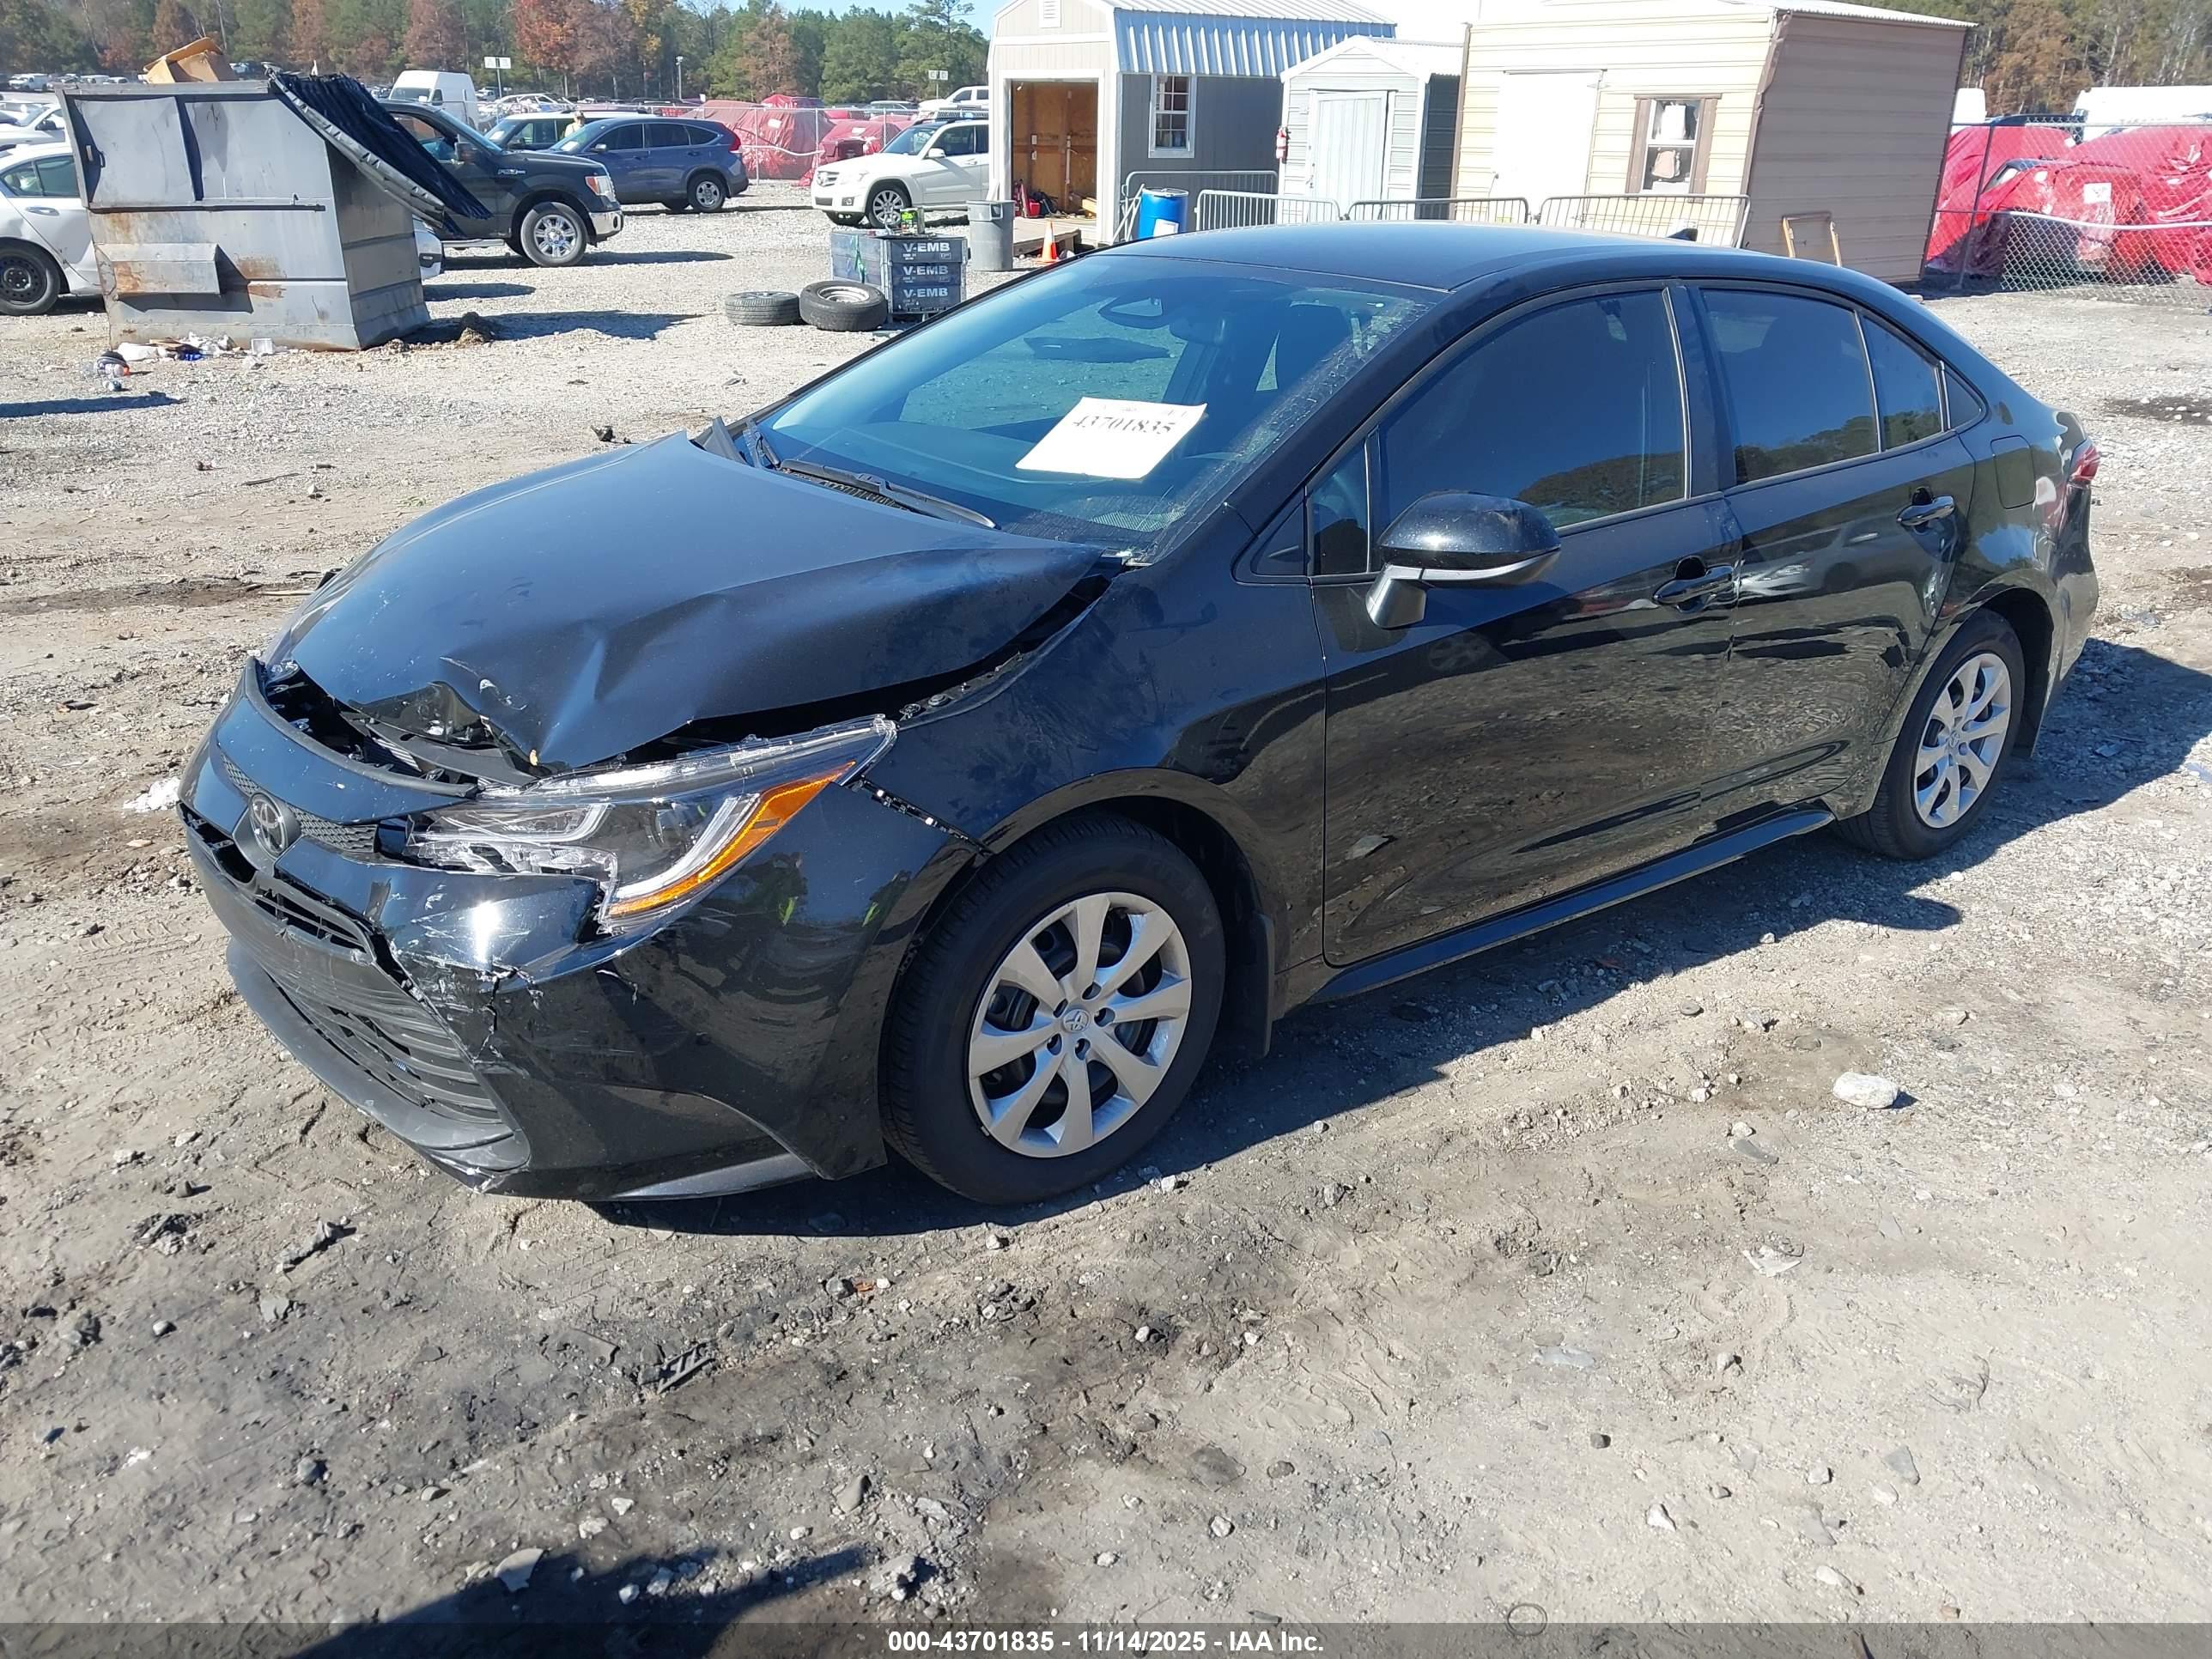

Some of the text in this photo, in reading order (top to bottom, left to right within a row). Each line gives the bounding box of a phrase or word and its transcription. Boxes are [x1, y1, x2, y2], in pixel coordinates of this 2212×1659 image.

[902, 242, 951, 252] V-EMB
[902, 265, 949, 276] V-EMB
[902, 288, 949, 298] V-EMB
